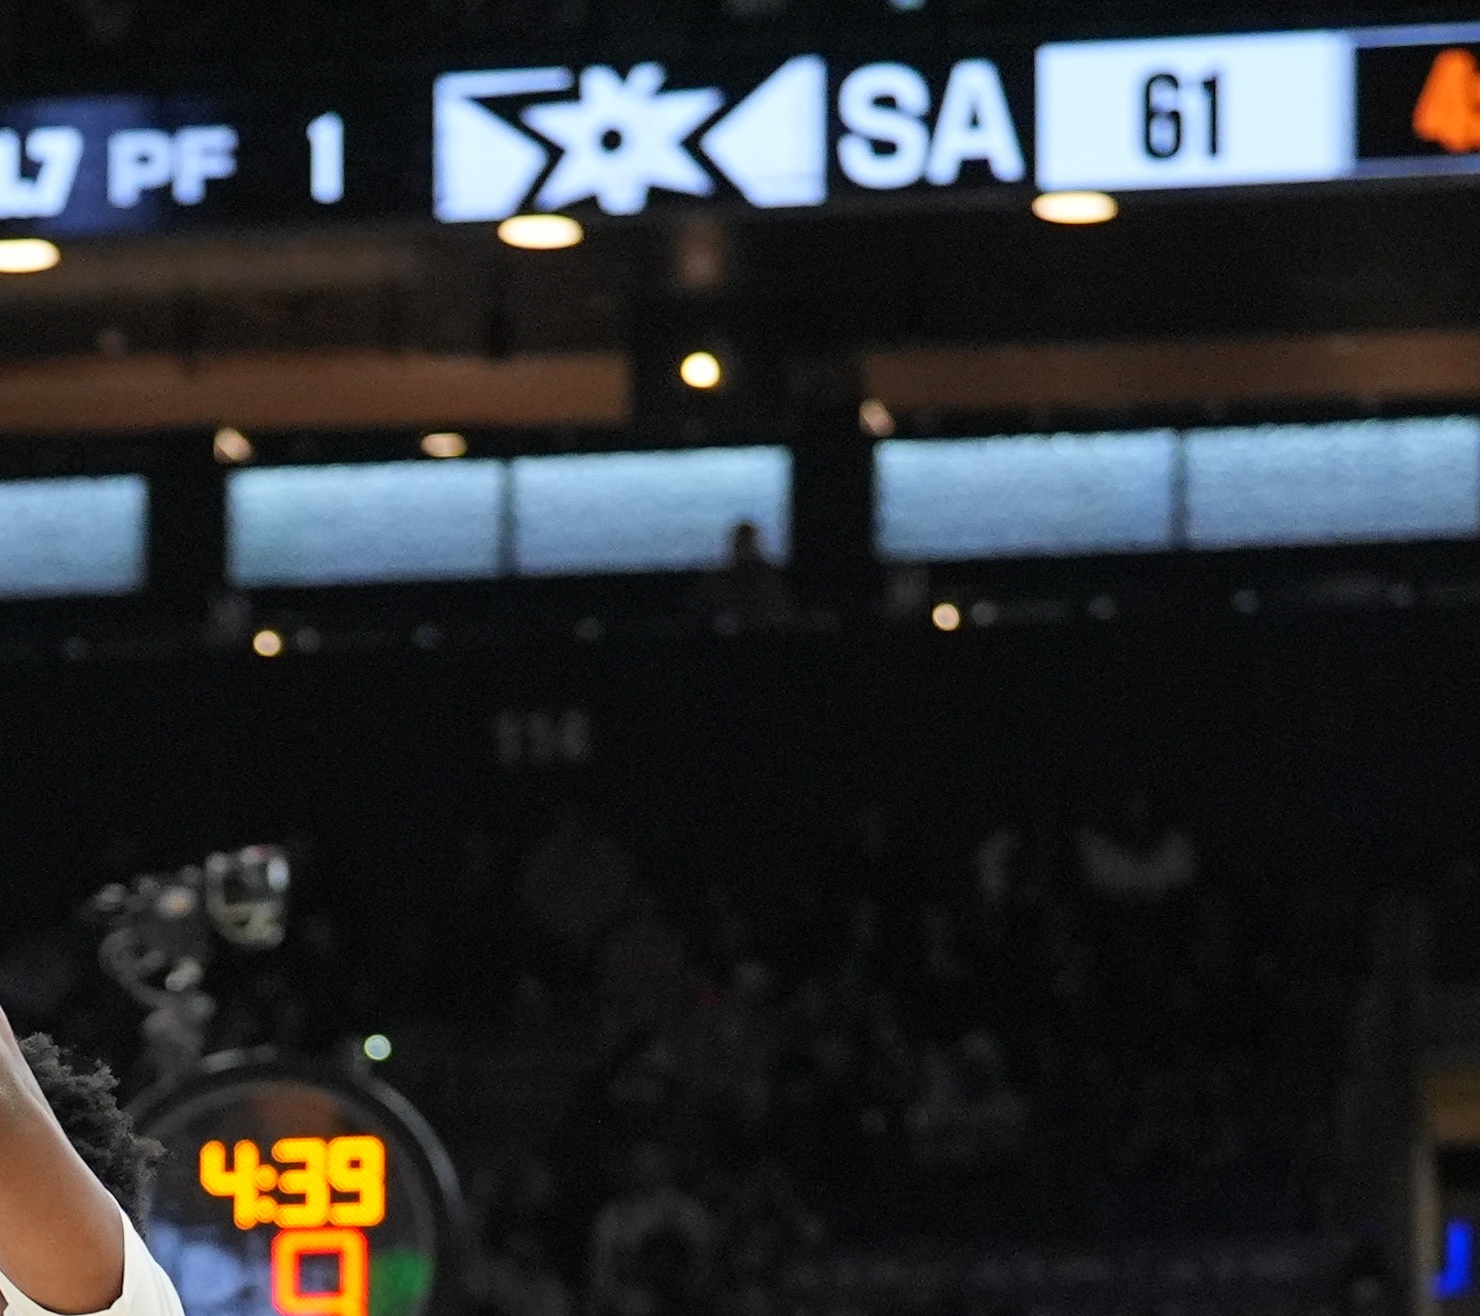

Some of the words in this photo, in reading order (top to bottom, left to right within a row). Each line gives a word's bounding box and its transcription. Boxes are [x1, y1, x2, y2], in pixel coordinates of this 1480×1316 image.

[105, 125, 238, 208] PF
[306, 112, 344, 204] 1
[838, 59, 1025, 189] SA
[1141, 73, 1220, 160] 61
[199, 1134, 387, 1231] 4:39
